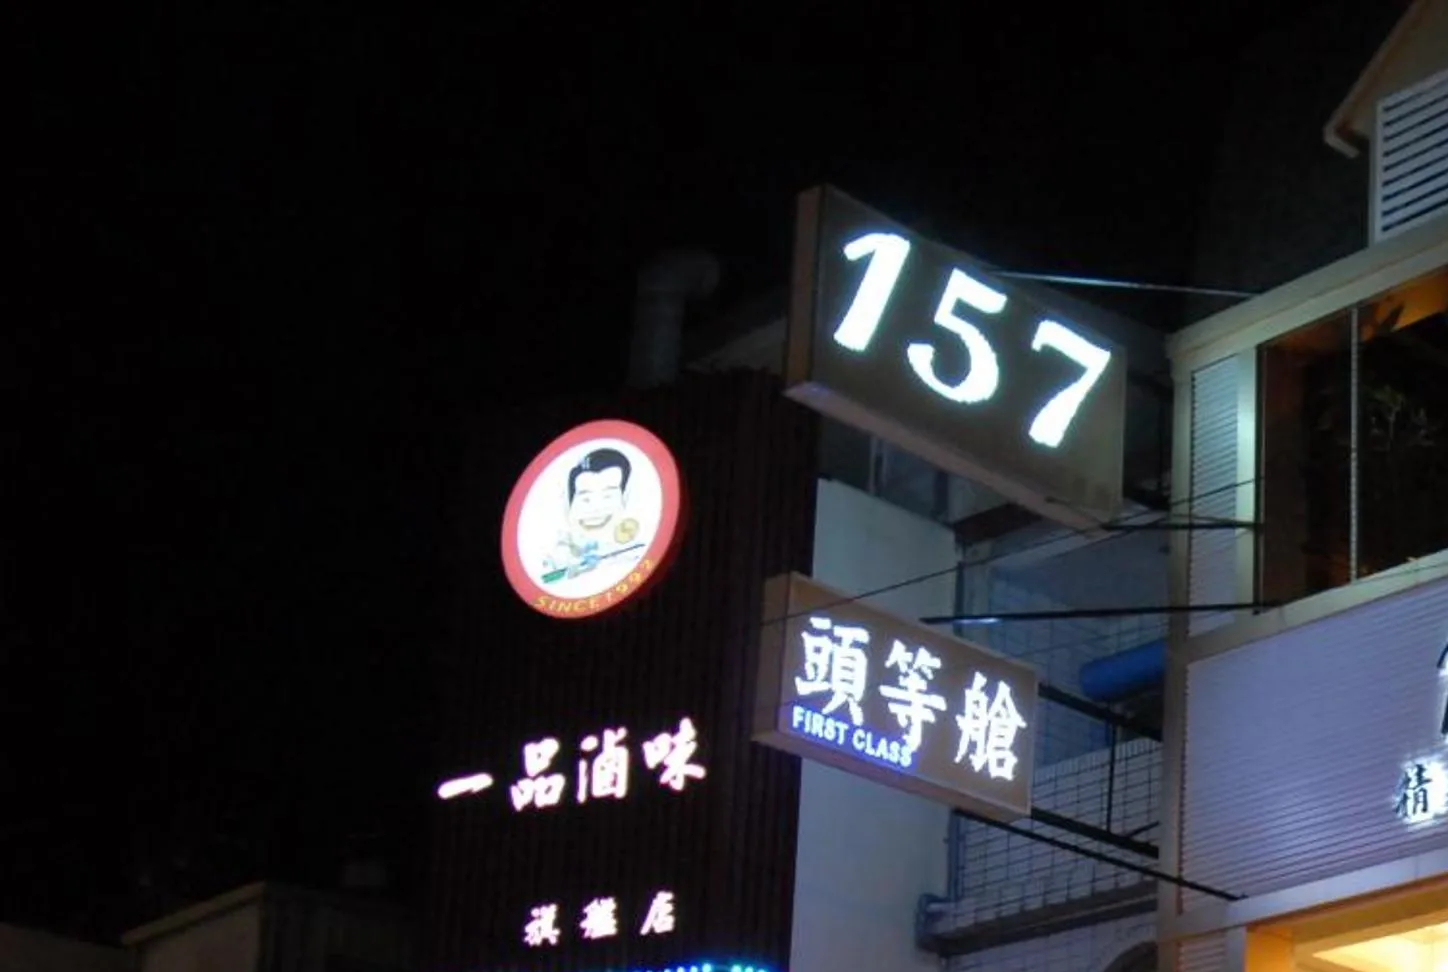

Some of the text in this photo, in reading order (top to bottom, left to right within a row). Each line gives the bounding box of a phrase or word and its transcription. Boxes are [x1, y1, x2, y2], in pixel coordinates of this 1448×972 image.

[833, 231, 1111, 449] 157
[534, 595, 600, 613] SINCE
[792, 705, 915, 769] FIRST CLASS
[793, 616, 1028, 782] 頭等艙
[437, 715, 707, 813] 一品滷味
